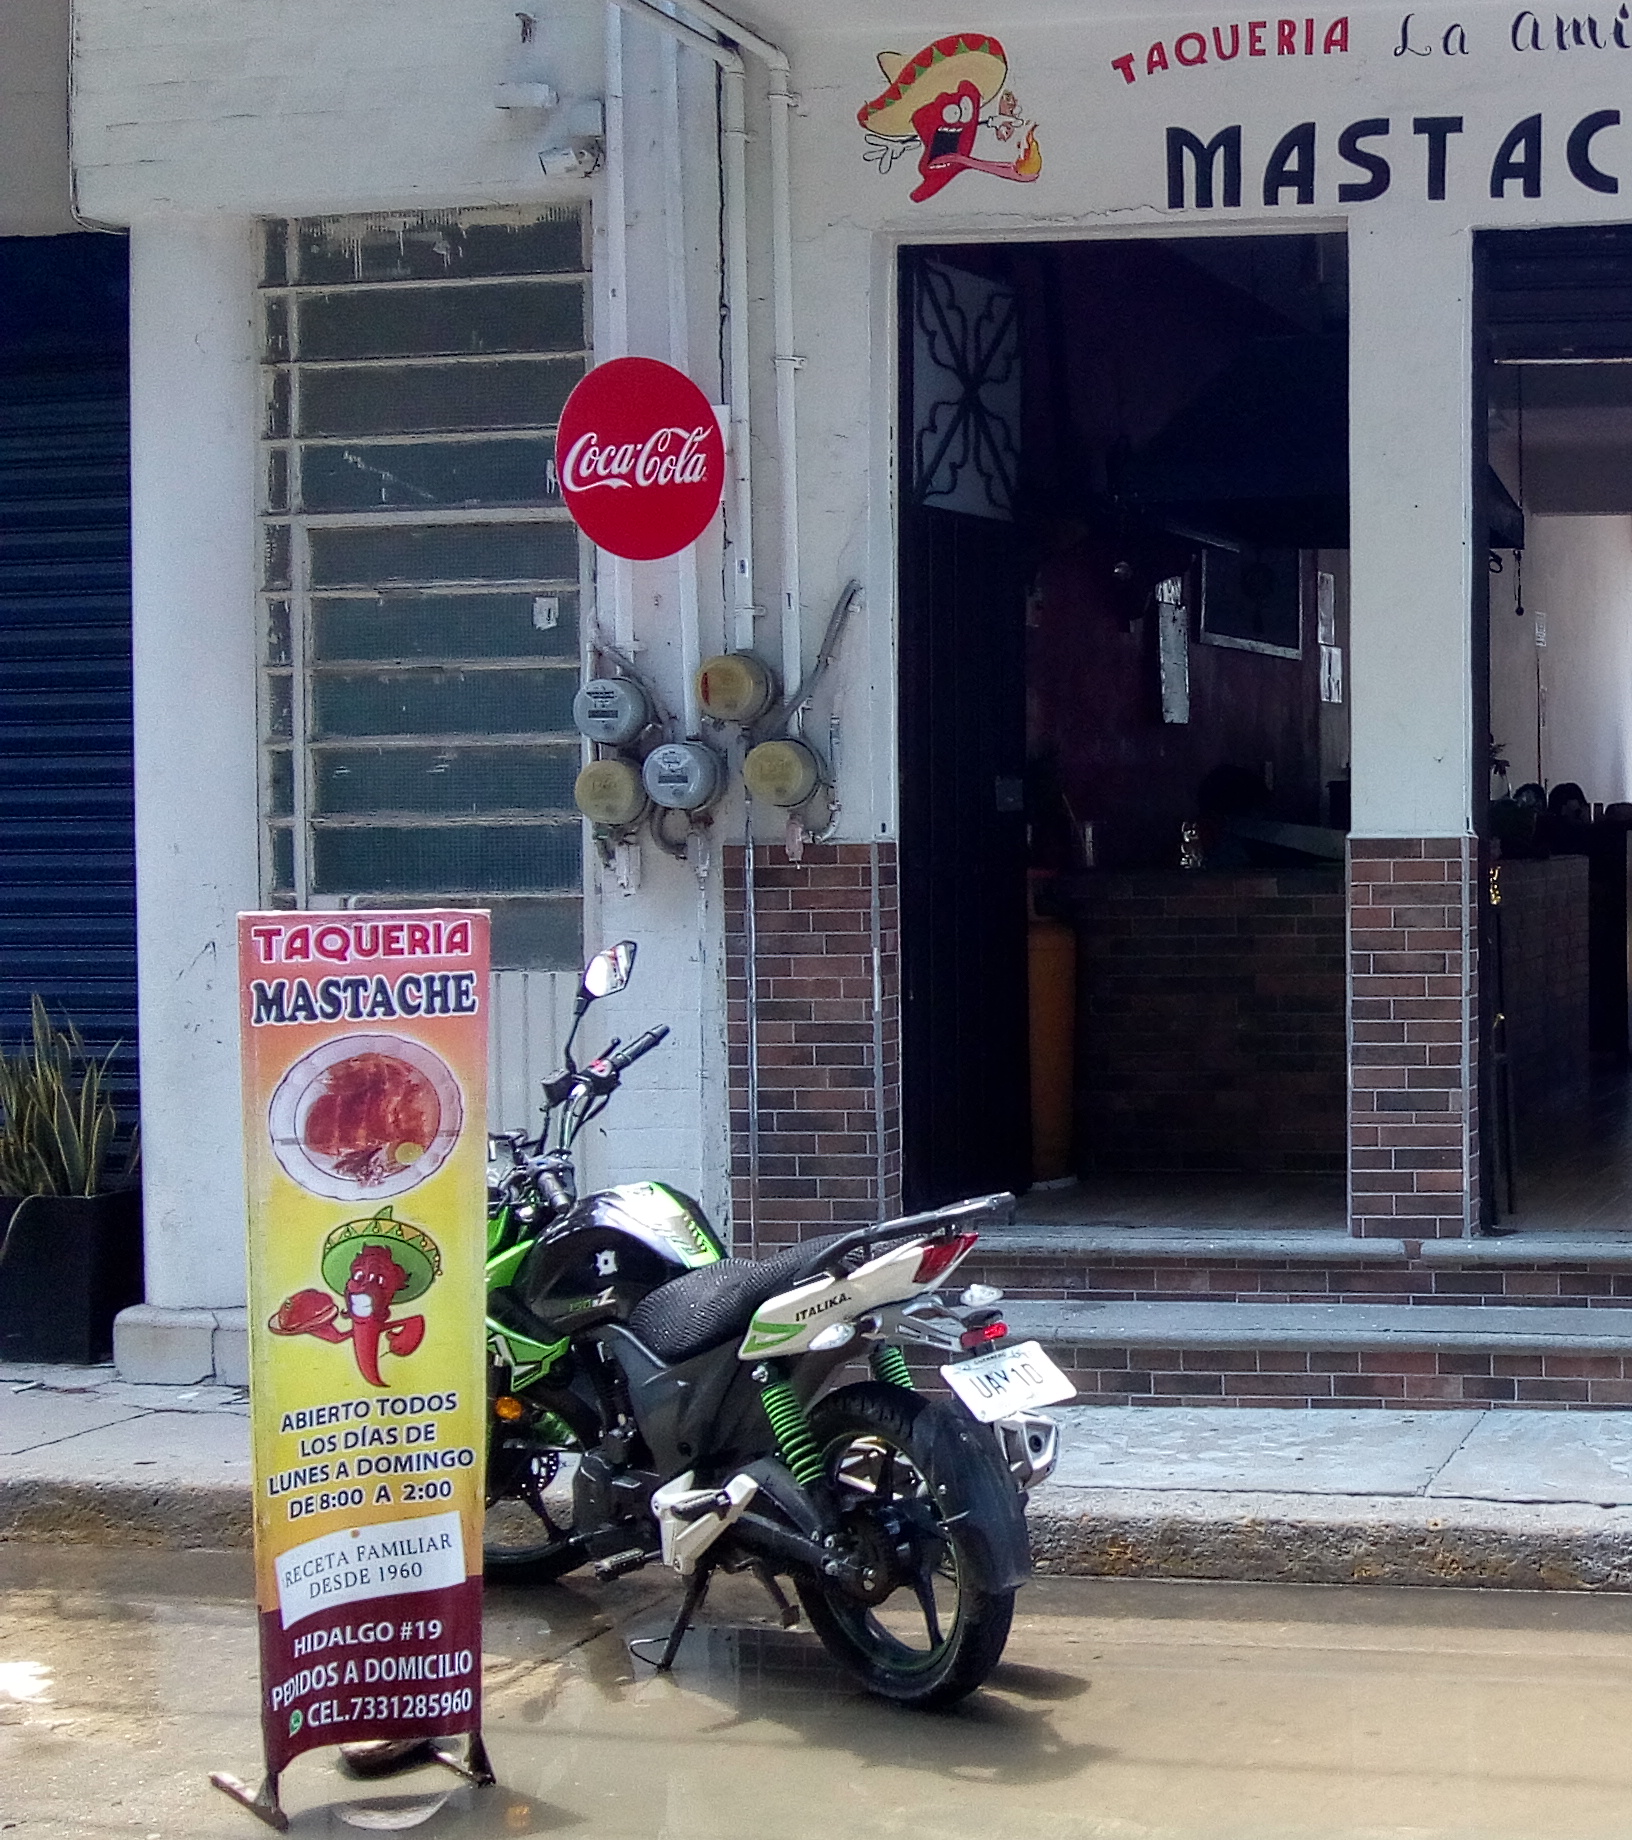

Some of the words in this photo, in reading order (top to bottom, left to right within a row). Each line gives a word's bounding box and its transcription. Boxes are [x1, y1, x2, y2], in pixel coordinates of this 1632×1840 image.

[1111, 16, 1350, 85] TAQUERIA
[1394, 13, 1470, 57] La
[562, 425, 714, 492] Coca-Cola
[253, 920, 471, 962] TAQUERIA
[252, 972, 477, 1025] MASTACHE
[795, 1292, 847, 1322] ITALIKA
[281, 1400, 371, 1432] ABIERTO
[376, 1392, 458, 1417] TODOS
[301, 1434, 337, 1458] LOS
[344, 1426, 398, 1450] DÍAS
[406, 1423, 436, 1445] DE
[268, 1464, 329, 1495] LUNES
[335, 1461, 350, 1480] A
[357, 1449, 475, 1476] DOMINGO
[289, 1497, 315, 1520] DE
[319, 1488, 364, 1511] 8:00
[375, 1484, 392, 1504] A
[403, 1480, 453, 1503] 2:00
[284, 1551, 350, 1588] RECETA
[357, 1533, 452, 1562] FAMILIAR
[309, 1568, 371, 1599] DESDE
[378, 1561, 422, 1583] 1960
[294, 1621, 395, 1659] HIDALGO
[400, 1619, 443, 1642] #19
[271, 1661, 340, 1711] PEDIDOS
[343, 1659, 359, 1685] A
[364, 1649, 473, 1683] DOMICILIO
